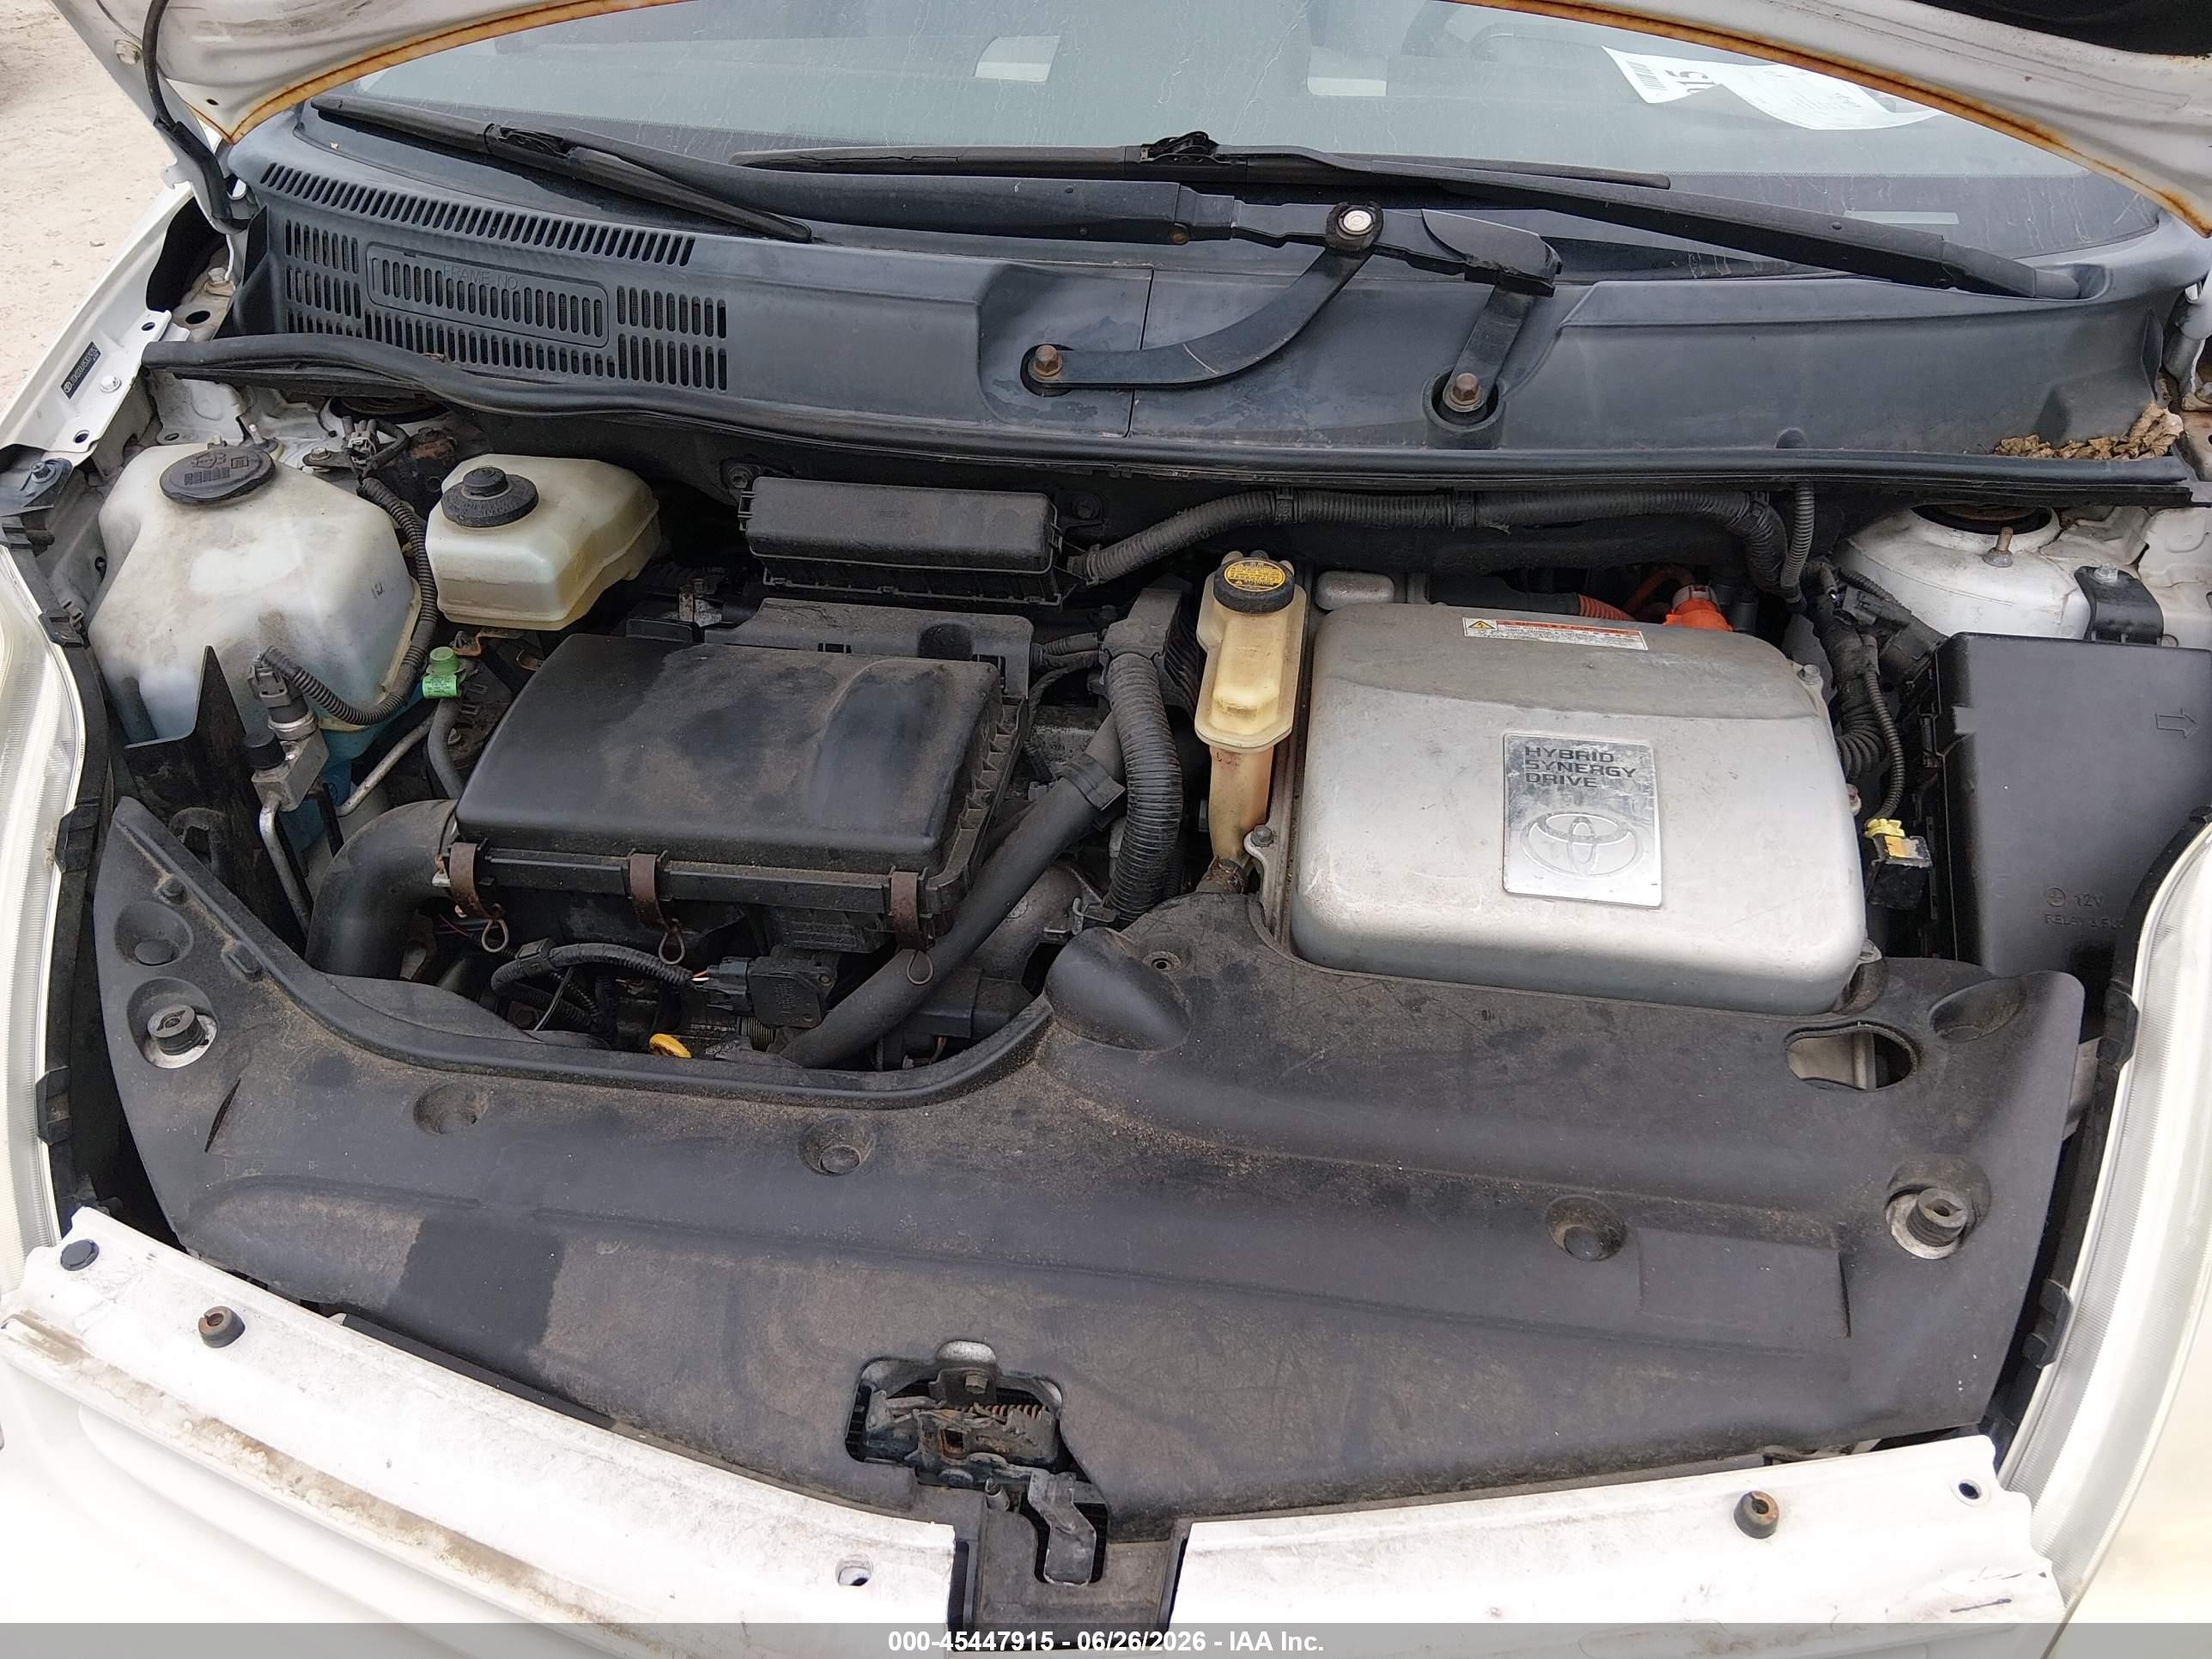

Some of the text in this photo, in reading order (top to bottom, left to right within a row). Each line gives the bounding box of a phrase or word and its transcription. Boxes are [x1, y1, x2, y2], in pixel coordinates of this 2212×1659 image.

[443, 264, 490, 286] FRAME
[1525, 746, 1614, 763] HYBRID
[1525, 759, 1637, 778] SYNERGY
[1525, 773, 1598, 788] DRIVE
